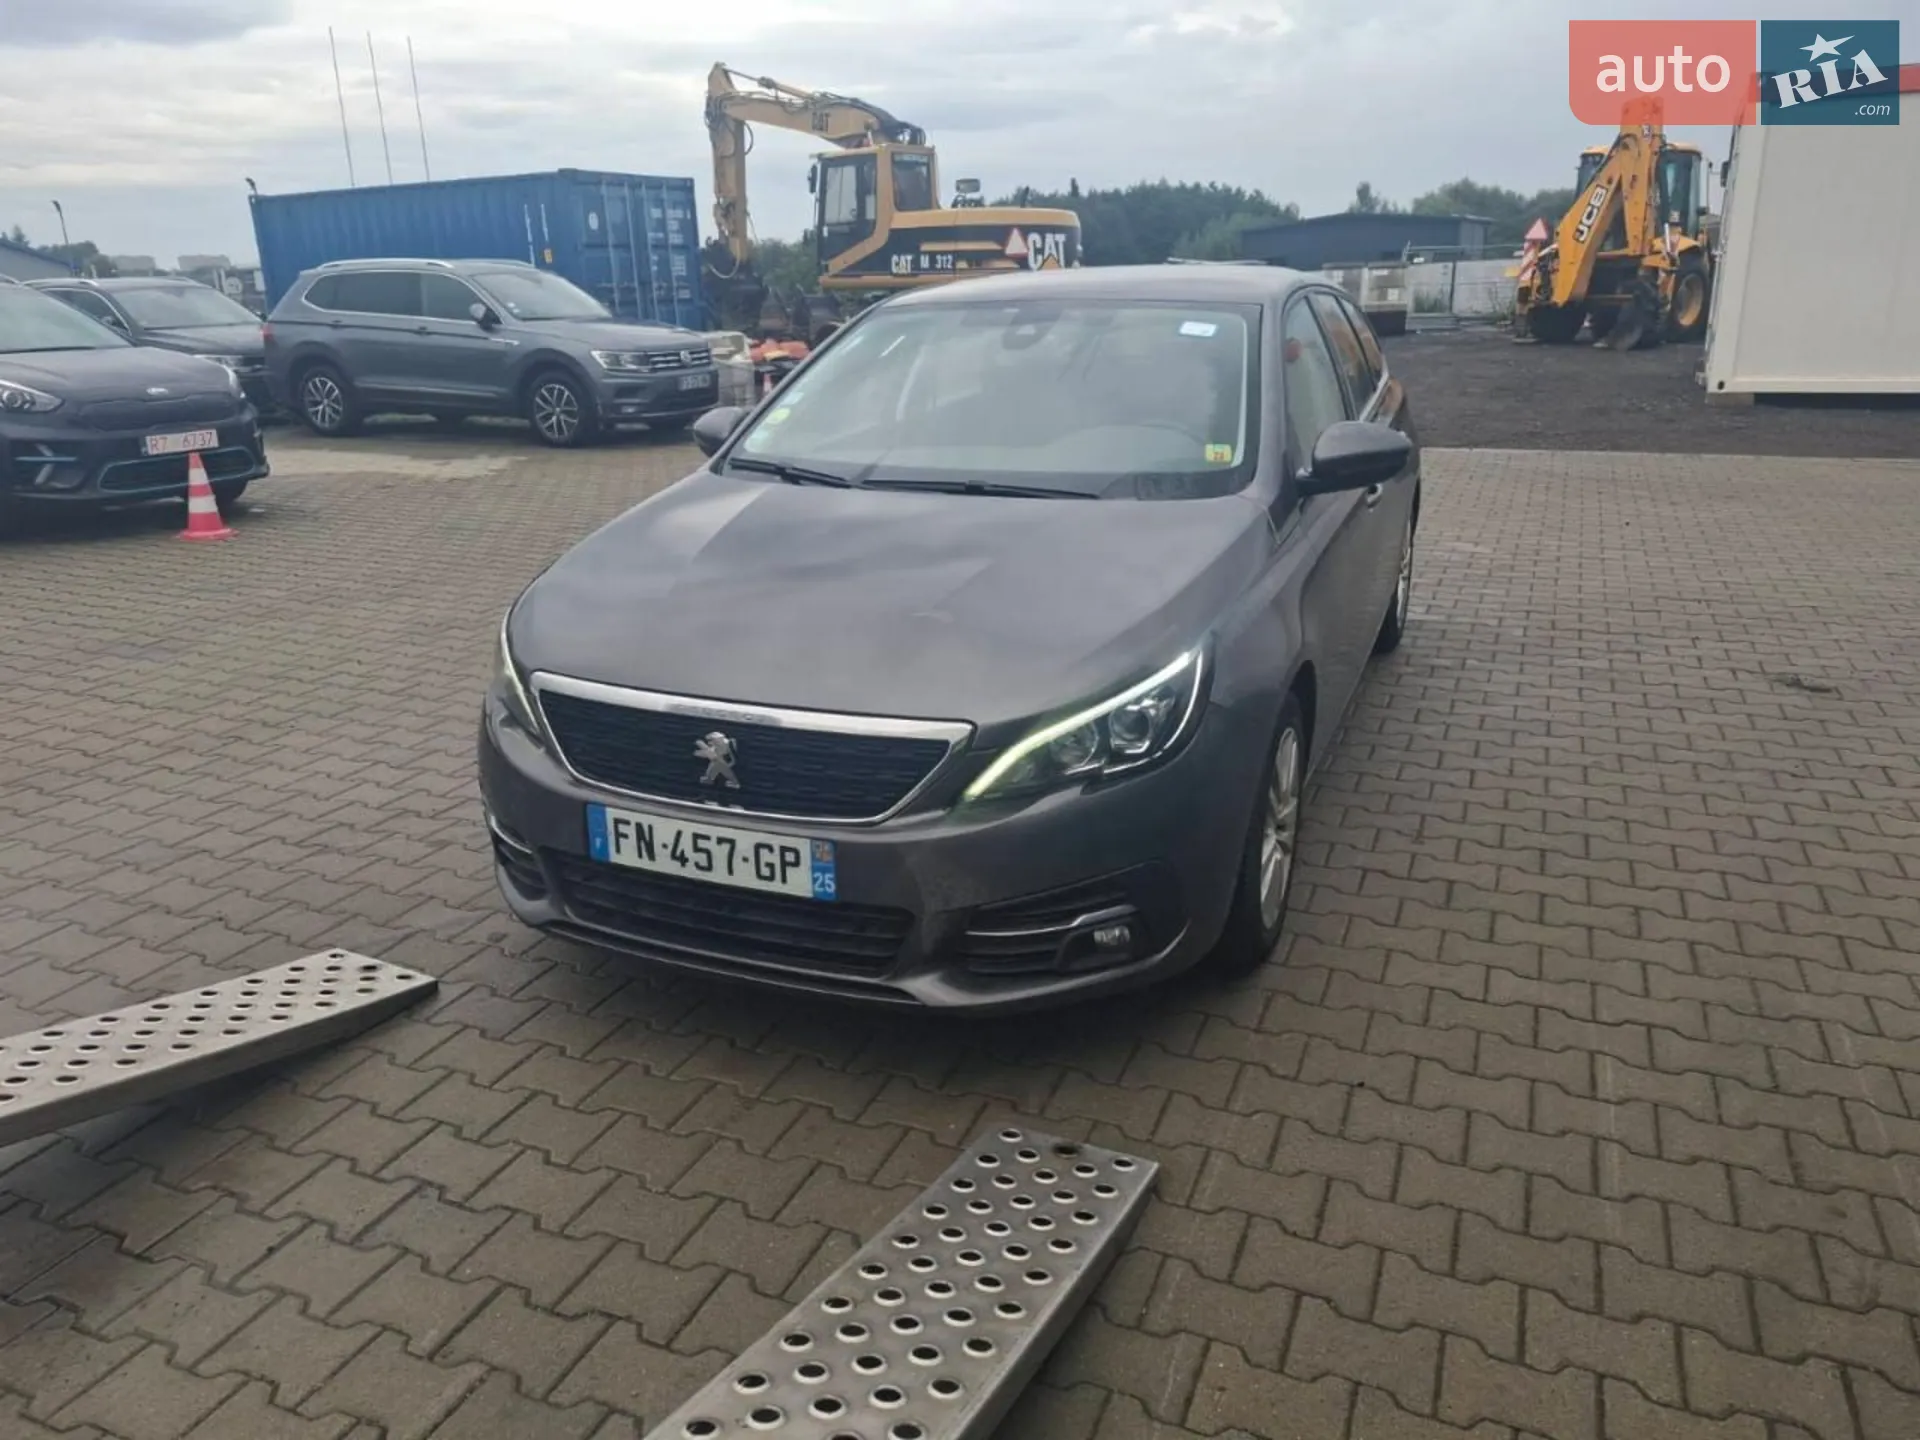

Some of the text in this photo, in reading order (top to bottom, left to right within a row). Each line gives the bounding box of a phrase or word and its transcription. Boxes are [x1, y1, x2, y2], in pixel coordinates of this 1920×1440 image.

[1574, 185, 1607, 242] JCB
[891, 253, 913, 275] CAT
[935, 254, 954, 270] 312
[1027, 232, 1067, 272] CAT
[612, 816, 801, 885] FN-457-GP
[813, 871, 836, 893] 25
